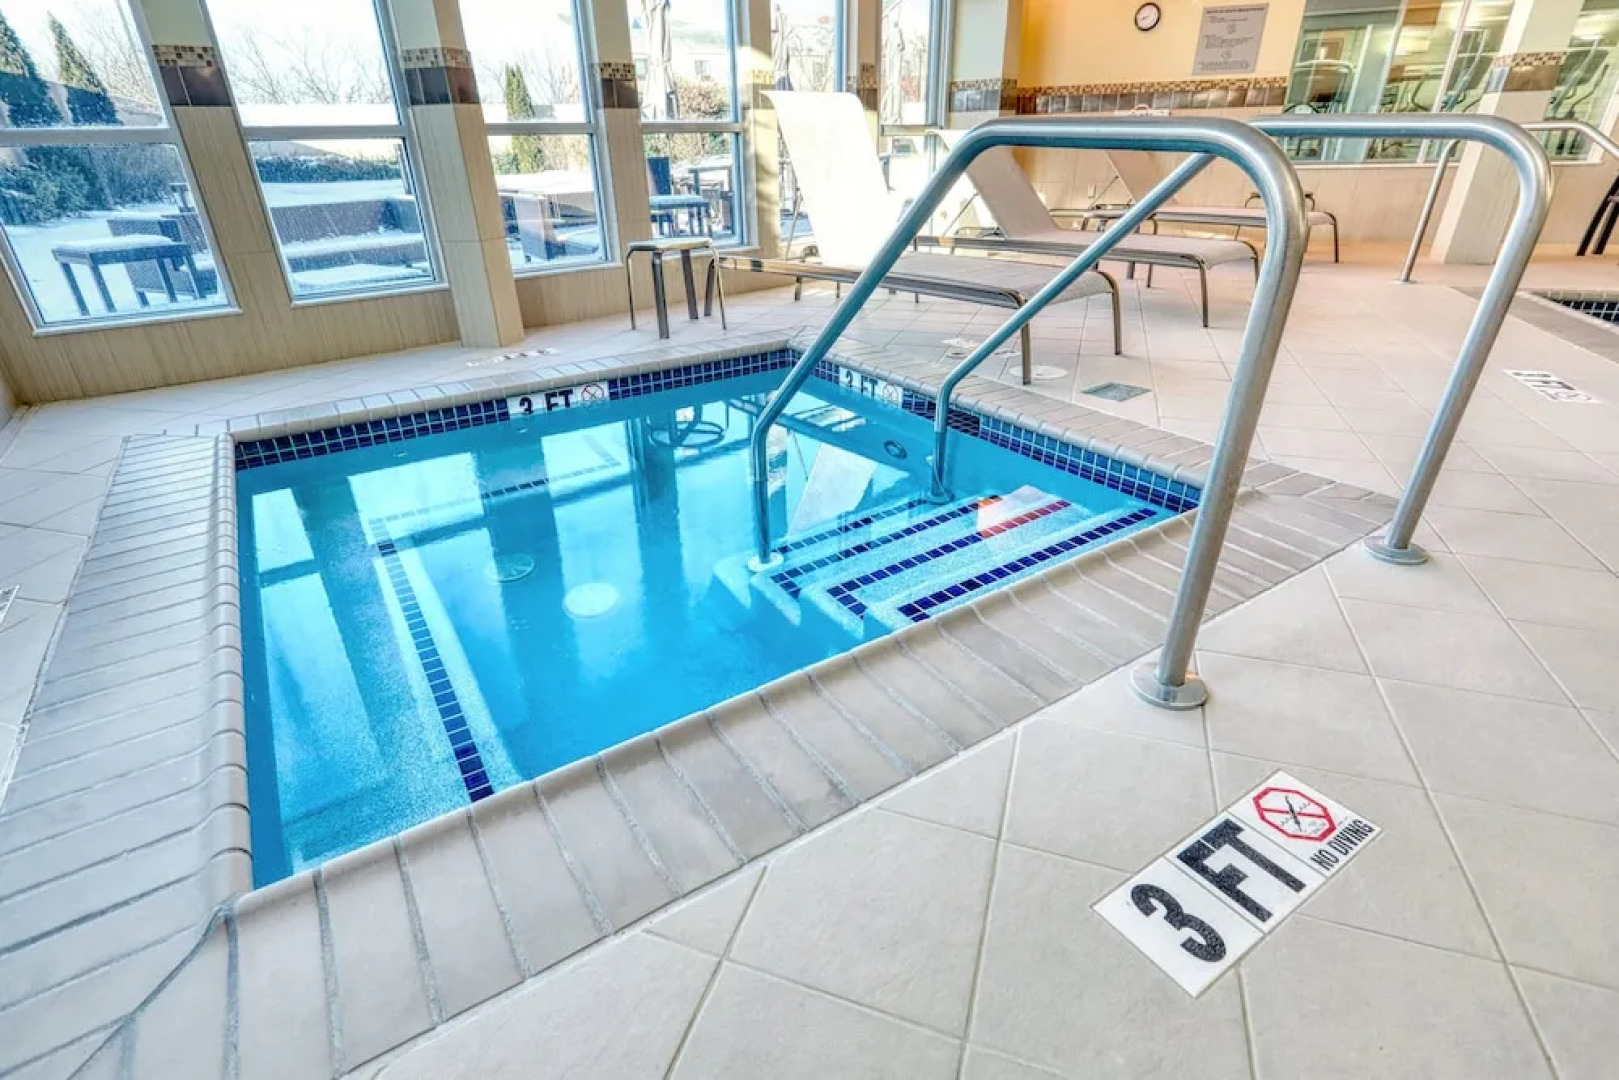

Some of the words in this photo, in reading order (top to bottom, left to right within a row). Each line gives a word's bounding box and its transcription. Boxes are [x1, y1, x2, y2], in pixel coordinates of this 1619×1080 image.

[545, 388, 573, 411] FT
[861, 375, 878, 398] FT
[1177, 818, 1307, 924] FT
[1310, 851, 1340, 872] NO
[1335, 818, 1375, 864] DIVING
[1130, 883, 1227, 962] 3
